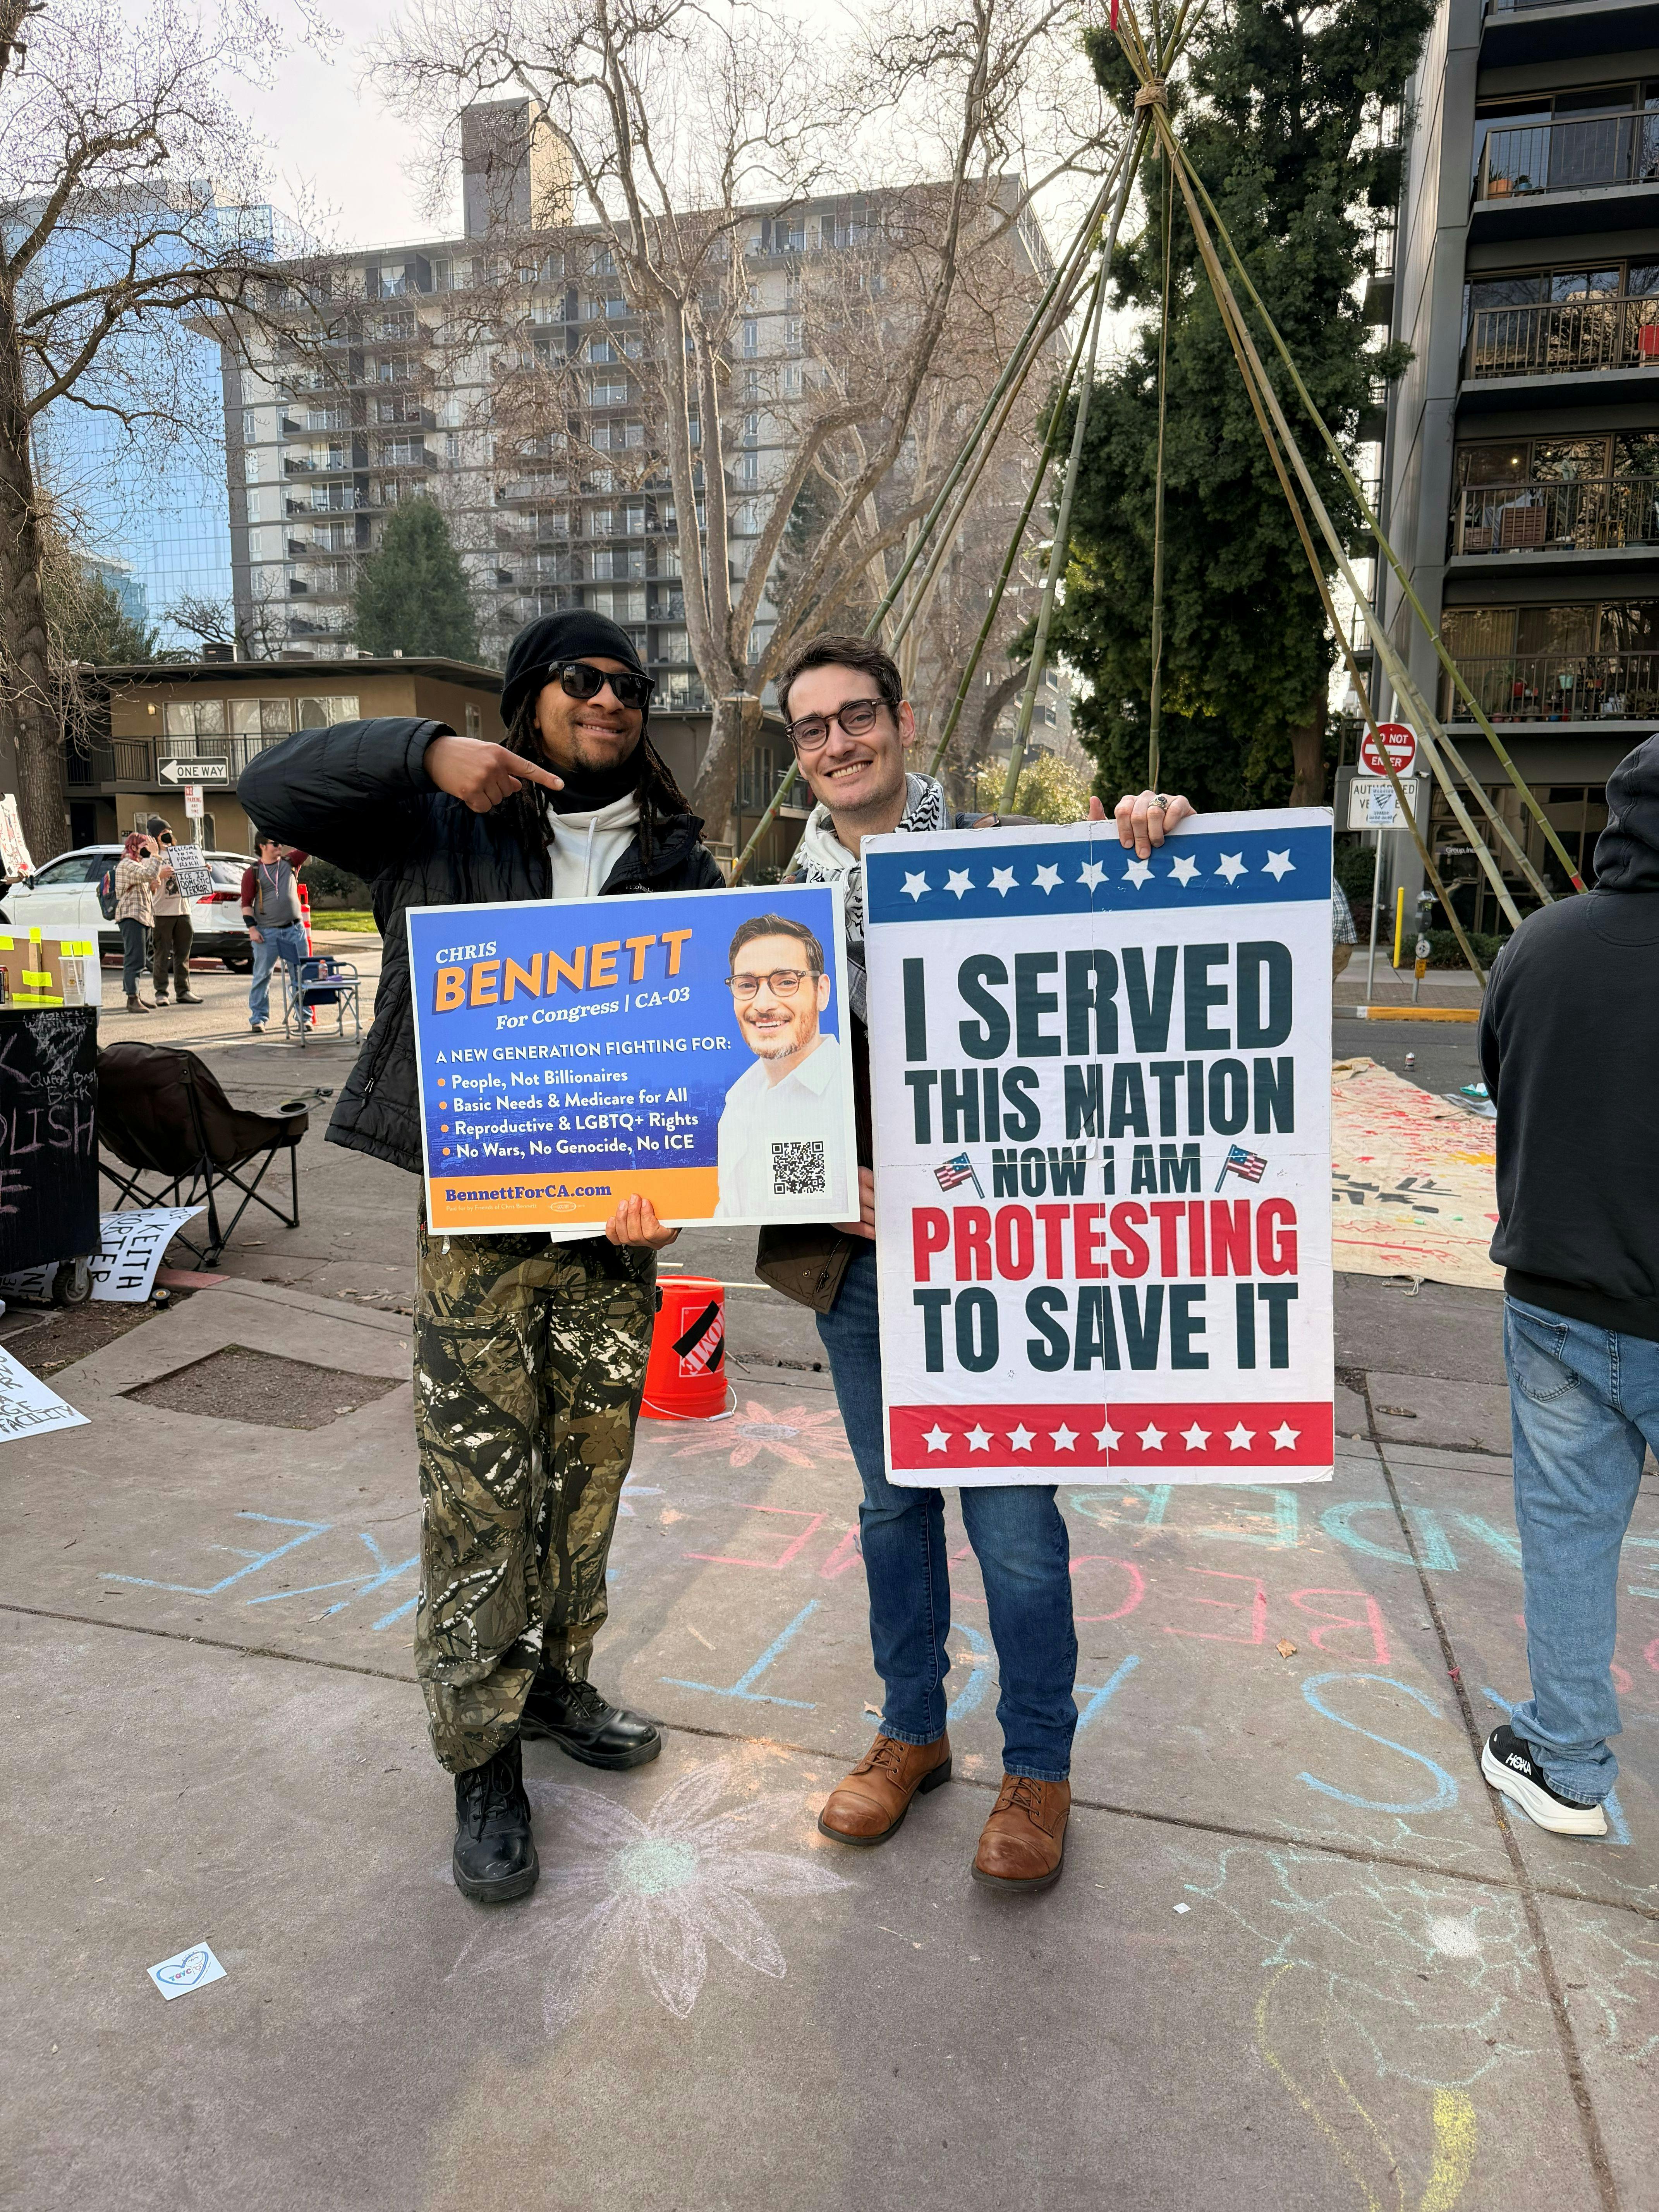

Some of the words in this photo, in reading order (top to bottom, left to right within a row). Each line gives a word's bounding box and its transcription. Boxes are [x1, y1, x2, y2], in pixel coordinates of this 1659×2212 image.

[1372, 734, 1385, 742] O
[1389, 734, 1409, 744] NOT
[177, 767, 199, 776] ONE
[201, 766, 224, 776] WAY
[1371, 757, 1403, 767] ENER
[185, 787, 193, 795] NO
[1353, 784, 1415, 794] AUTED
[178, 872, 192, 880] ICE
[179, 878, 210, 889] DOMESTIC
[183, 884, 210, 895] TERROR
[436, 941, 497, 964] CHRIS
[436, 930, 691, 1011] BENNETT
[496, 1015, 529, 1030] For
[532, 1001, 619, 1024] Congress
[635, 986, 690, 1008] CA-03
[903, 958, 927, 1062] I
[957, 941, 1293, 1060] SERVED
[436, 1050, 447, 1063] A
[451, 1048, 488, 1063] NEW
[493, 1042, 601, 1060] GENERATION
[606, 1038, 687, 1055] FIGHTING
[692, 1036, 731, 1051] FOR:
[452, 1073, 507, 1092] People,
[511, 1072, 540, 1086] Not
[544, 1068, 628, 1085] Billionaires
[453, 1097, 491, 1112] Basic
[496, 1094, 543, 1110] Needs
[548, 1093, 560, 1108] &
[565, 1091, 635, 1107] Medicare
[639, 1089, 661, 1104] for
[665, 1087, 687, 1103] All
[904, 1066, 1041, 1144] THIS
[1065, 1056, 1295, 1139] NATION
[455, 1118, 554, 1139] Reproductive
[558, 1116, 571, 1131] &
[575, 1113, 644, 1132] LGBTQ+
[649, 1111, 699, 1130] Rights
[457, 1143, 479, 1158] No
[482, 1142, 525, 1159] Wars,
[529, 1140, 552, 1155] No
[556, 1137, 632, 1155] Genocide,
[637, 1136, 659, 1151] No
[664, 1134, 694, 1149] ICE
[992, 1145, 1087, 1198] NOW
[1103, 1145, 1115, 1195] I
[1131, 1143, 1201, 1194] AM
[446, 1185, 610, 1201] BennettForCA.com
[89, 1213, 155, 1283] PORTER
[912, 1198, 1297, 1282] PROTESTING
[116, 1224, 170, 1289] KEITH
[913, 1287, 999, 1373] TO
[1025, 1284, 1209, 1372] SAVE
[1236, 1282, 1298, 1369] IT
[1505, 1753, 1531, 1776] HOKA
